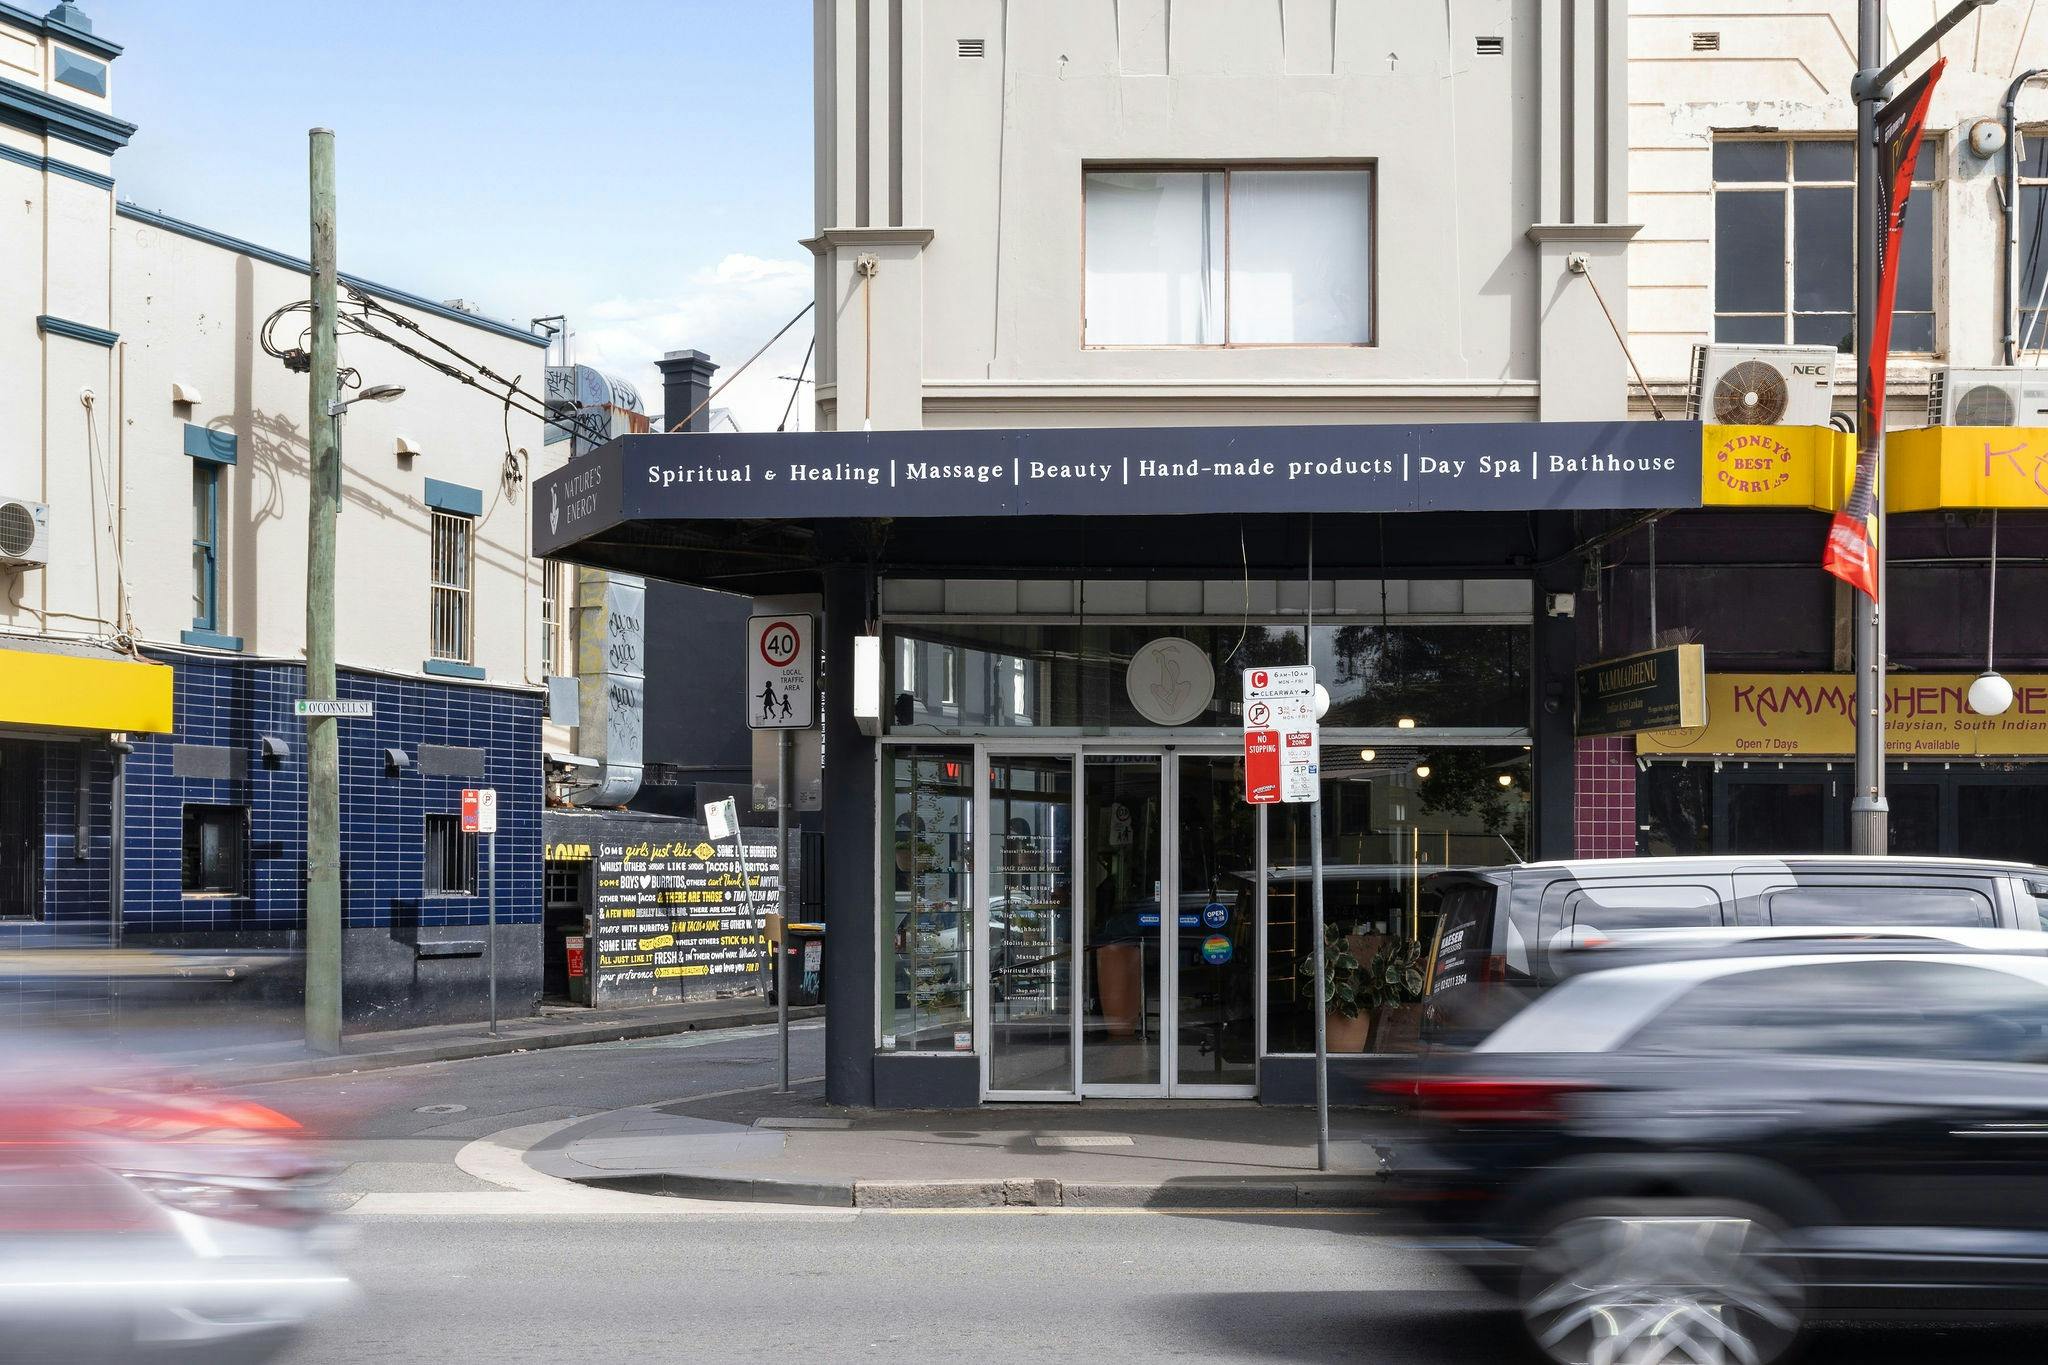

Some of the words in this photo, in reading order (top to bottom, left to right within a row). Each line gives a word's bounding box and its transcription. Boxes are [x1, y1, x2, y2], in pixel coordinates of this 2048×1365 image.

[1793, 366, 1826, 376] NEC
[1717, 435, 1792, 462] SYDNEY'S
[1734, 458, 1774, 470] BEST
[648, 464, 752, 487] Spiritual
[764, 470, 776, 480] &
[790, 463, 880, 484] Healing
[906, 462, 1003, 482] Massage
[1030, 462, 1112, 482] Beauty
[1139, 458, 1275, 477] Hand-made
[1288, 458, 1392, 480] products
[1420, 456, 1466, 478] Day
[1479, 454, 1520, 478] Spa
[1550, 454, 1676, 472] Bathhouse
[564, 466, 601, 500] NATURE'S
[567, 492, 598, 524] ENERGY
[767, 634, 794, 654] 40
[309, 702, 358, 713] O'CONNELL
[360, 703, 369, 713] ST
[1734, 685, 1979, 727] KAMMHEN
[1885, 720, 1947, 732] alaysian,
[1954, 720, 1996, 730] South
[2002, 720, 2046, 730] Indian
[1258, 735, 1267, 743] NO
[1736, 739, 1762, 751] Open
[1765, 739, 1770, 748] 7
[1774, 739, 1798, 751] Days
[1915, 740, 1960, 750] Available
[1249, 745, 1276, 753] STOPPING
[600, 844, 623, 857] SOME
[623, 842, 648, 864] girls
[650, 842, 672, 861] just
[672, 842, 692, 857] like
[735, 846, 748, 857] LKE
[600, 862, 622, 872] WHILST
[624, 862, 646, 872] OTHERS
[667, 862, 686, 871] LIKE
[705, 862, 728, 873] TACOS
[620, 876, 639, 888] BOYS
[760, 876, 779, 887] ANYTH
[638, 892, 656, 904] TACOS
[665, 892, 687, 903] THERE
[688, 891, 700, 902] ARE
[702, 891, 723, 902] THOSE
[610, 909, 622, 918] FEW
[639, 924, 669, 932] BURRITOS
[730, 920, 745, 929] OTHER
[600, 940, 619, 952] SOME
[622, 939, 636, 951] LIKE
[720, 936, 739, 945] STICK
[749, 935, 765, 944] MD.
[600, 955, 612, 964] ALL
[613, 955, 629, 963] JUST
[631, 954, 644, 963] LIKE
[654, 951, 677, 964] FRESH
[678, 951, 684, 963] &
[599, 973, 616, 988] your
[616, 969, 653, 985] preference
[710, 964, 714, 974] &
[715, 965, 722, 973] we
[723, 963, 734, 972] love
[735, 964, 745, 973] you
